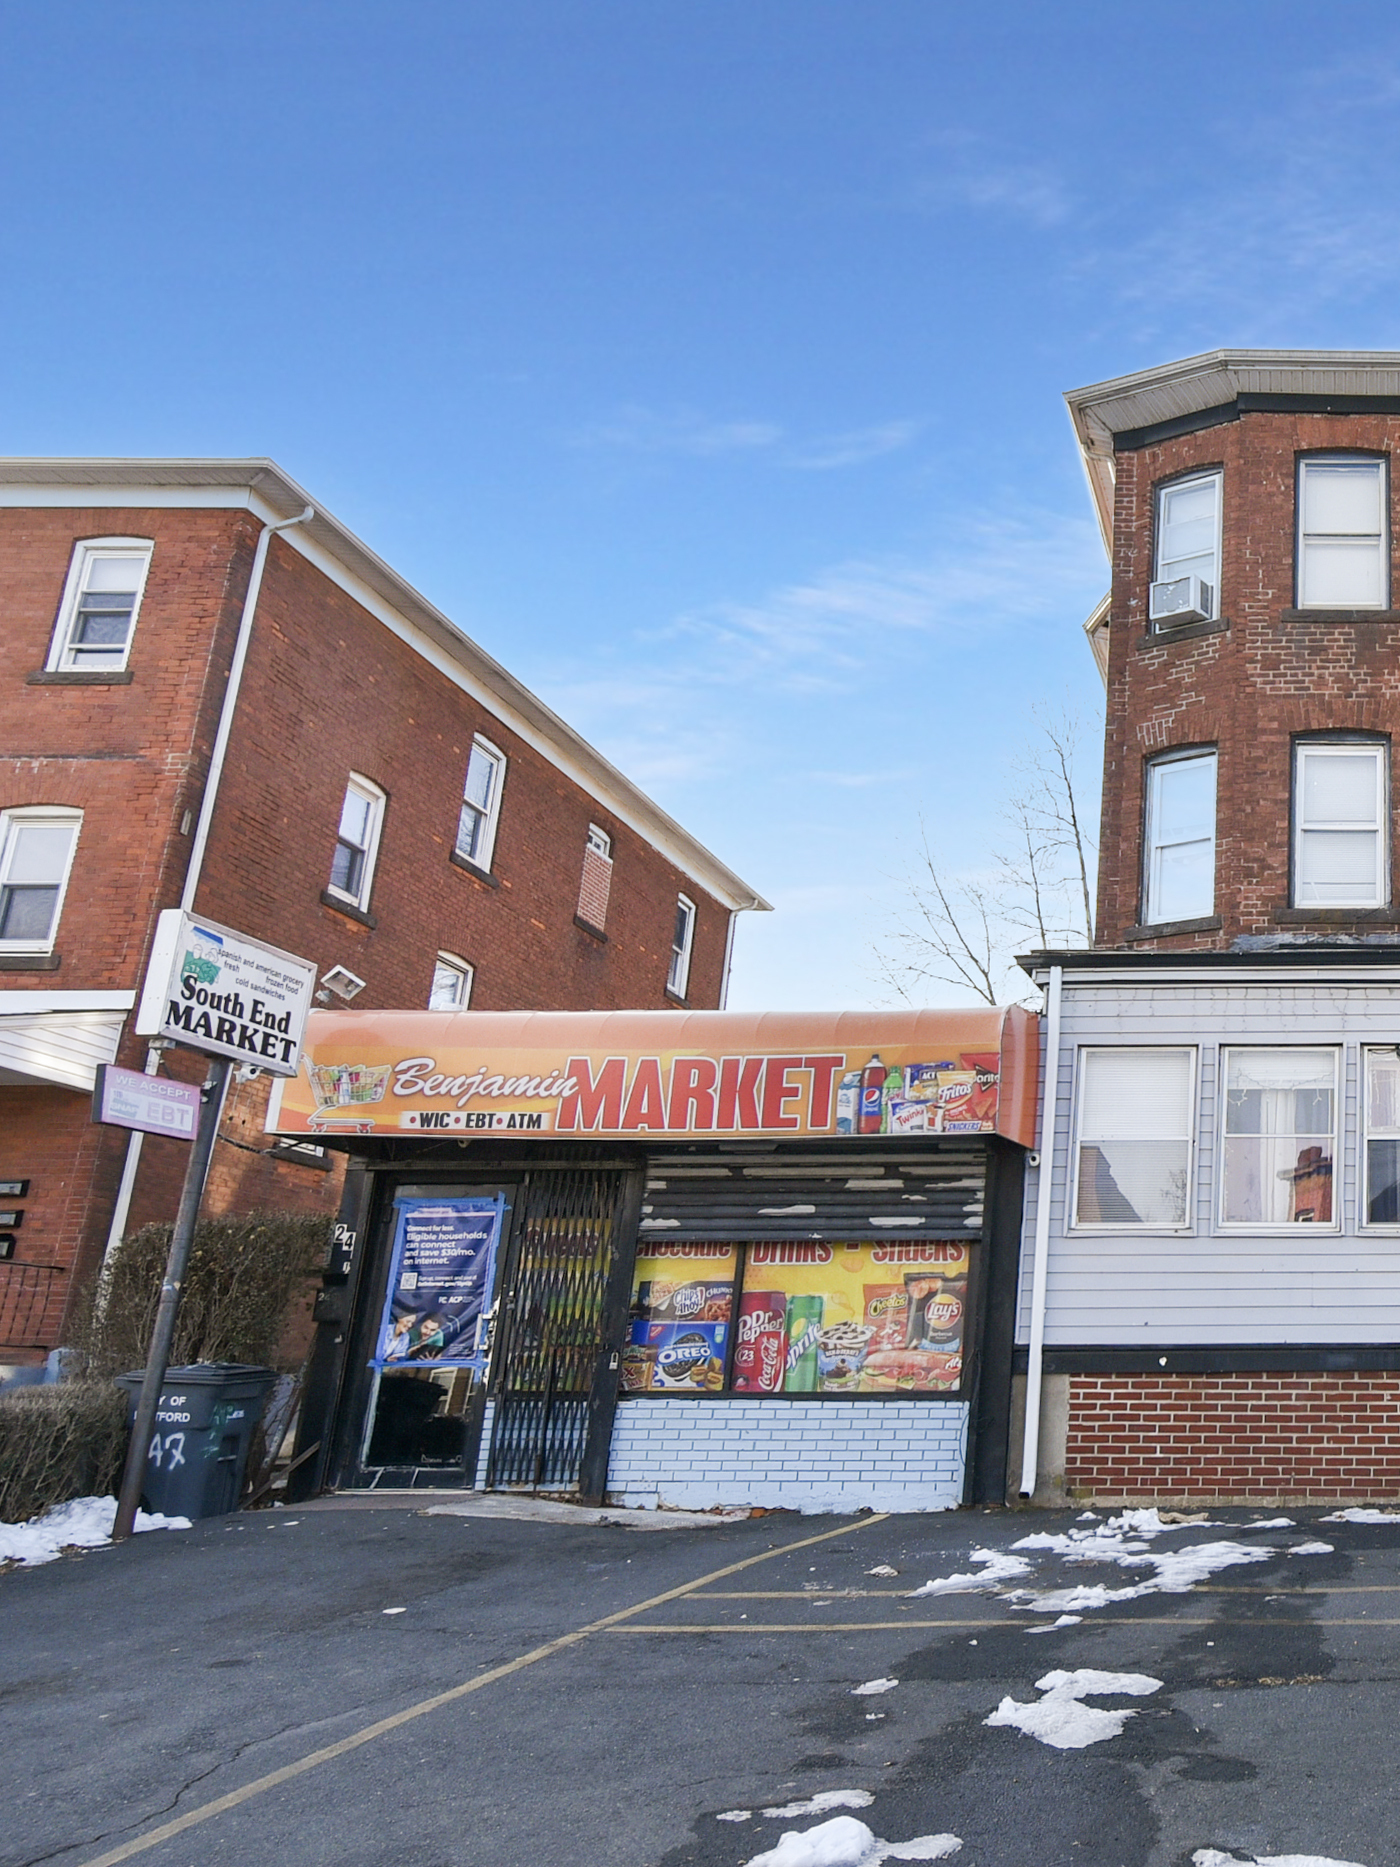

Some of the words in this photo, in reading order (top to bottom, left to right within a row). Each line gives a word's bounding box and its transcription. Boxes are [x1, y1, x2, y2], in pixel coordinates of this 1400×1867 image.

[223, 960, 240, 973] fresh
[242, 957, 255, 968] and
[255, 963, 282, 979] american
[282, 974, 304, 989] grocery
[235, 977, 249, 988] cold
[250, 982, 286, 1001] sandwiches
[265, 975, 284, 990] frozen
[285, 983, 299, 996] food
[181, 974, 245, 1020] South
[249, 998, 292, 1035] End
[165, 999, 297, 1064] MARKET
[116, 1073, 137, 1088] WE
[139, 1081, 191, 1100] ACCEPT
[392, 1056, 580, 1108] Benjamin
[554, 1055, 847, 1133] MARKET
[938, 1083, 973, 1102] Fritos
[147, 1100, 189, 1127] EBT
[419, 1112, 451, 1128] WIC
[465, 1112, 497, 1129] EBT
[506, 1113, 542, 1129] ATM
[896, 1107, 924, 1126] Twinki
[947, 1121, 980, 1131] SNICKERS
[407, 1233, 438, 1241] Eligible
[439, 1231, 488, 1240] households
[441, 1248, 476, 1256] $30/mo.
[675, 1288, 699, 1302] Chips
[869, 1295, 907, 1318] Cheetos
[928, 1301, 959, 1322] Lay's
[751, 1310, 773, 1328] Dr
[737, 1315, 783, 1344] Pepper
[658, 1347, 711, 1364] OREO
[742, 1349, 755, 1361] 23
[169, 1396, 187, 1406] OF
